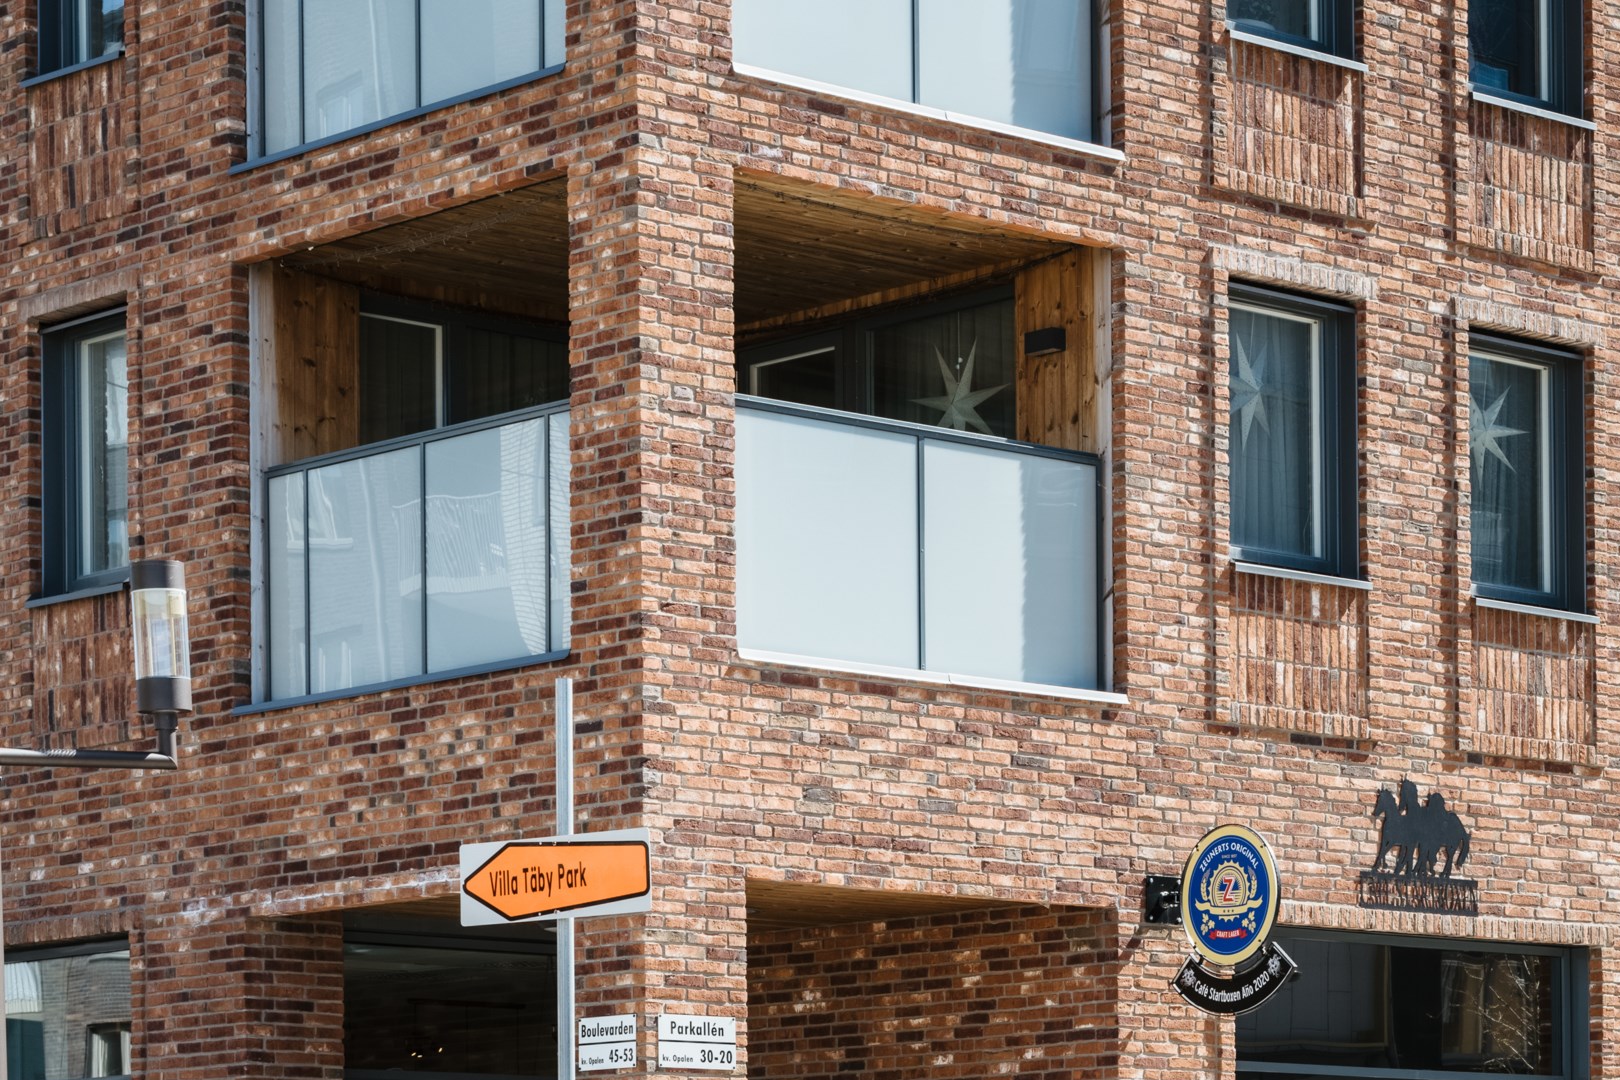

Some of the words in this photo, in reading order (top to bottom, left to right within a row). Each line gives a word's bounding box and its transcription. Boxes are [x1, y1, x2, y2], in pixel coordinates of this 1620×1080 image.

[1199, 842, 1229, 872] ZEUNERTS
[1230, 842, 1259, 869] ORIGINAL
[489, 869, 518, 897] Villa
[522, 865, 553, 897] Täby
[558, 860, 587, 889] Park
[1222, 875, 1236, 904] Z
[1216, 930, 1228, 938] CRAFT
[1194, 980, 1209, 997] Café
[1208, 987, 1241, 1003] Startboxen
[1241, 983, 1254, 999] Año
[1253, 970, 1270, 992] 2020
[581, 1020, 634, 1038] Boulevarden
[670, 1020, 724, 1037] Parkallén
[588, 1056, 604, 1066] Opalen
[609, 1047, 634, 1063] 45-53
[662, 1053, 671, 1062] kv.
[672, 1054, 693, 1063] Opalen
[700, 1049, 733, 1064] 30-20
